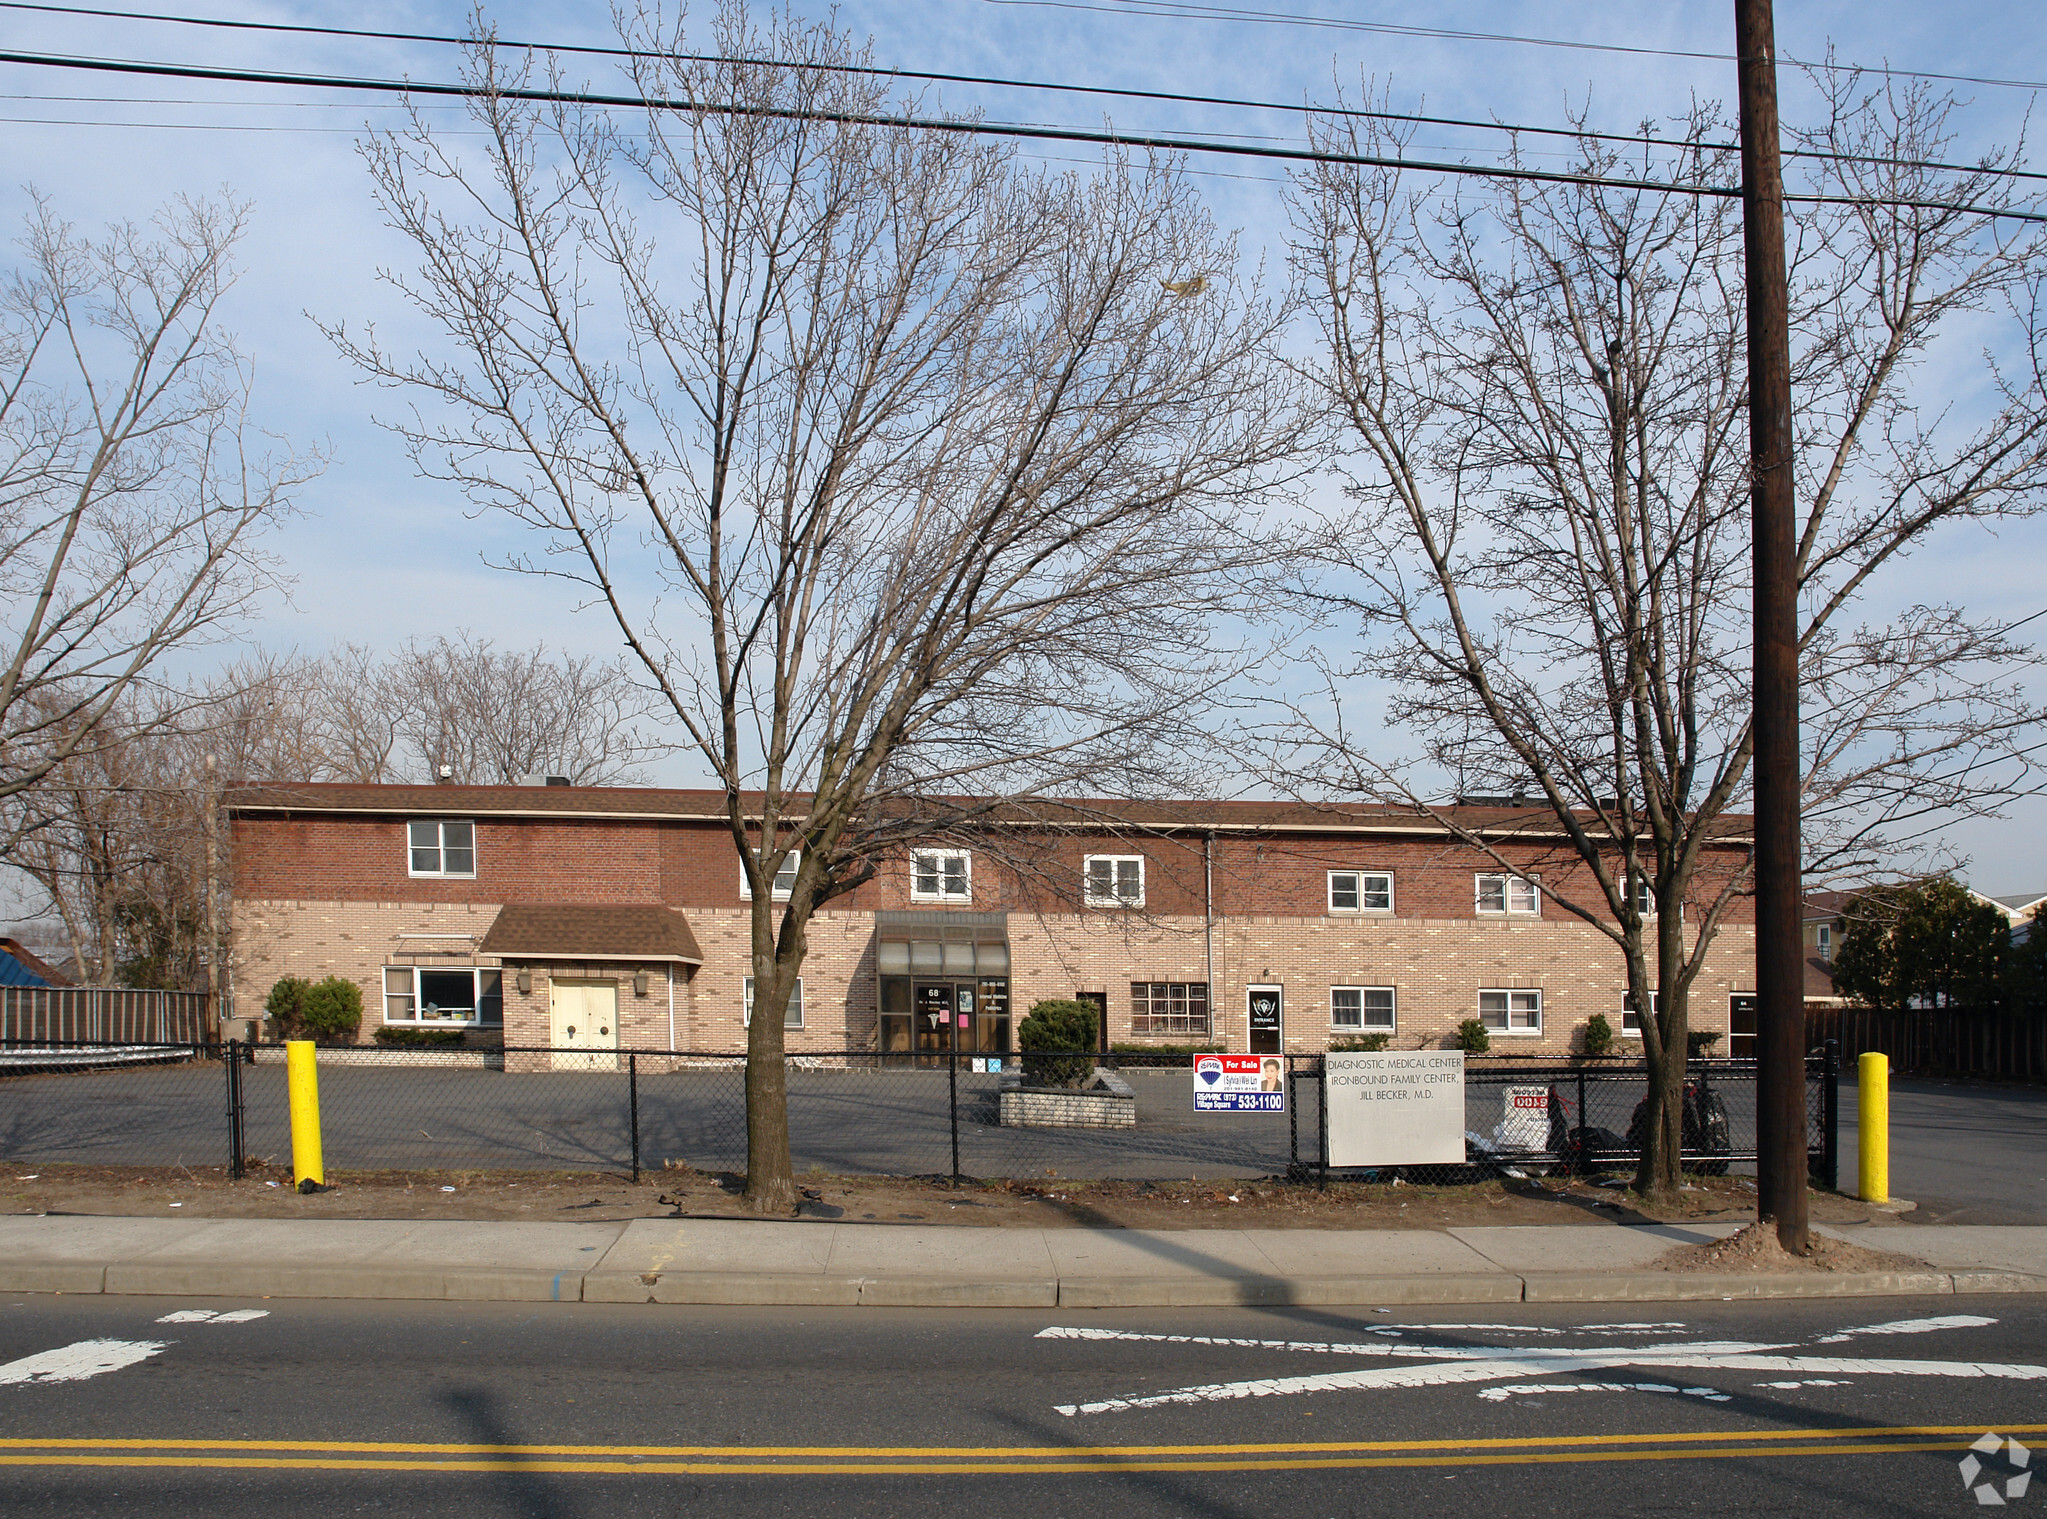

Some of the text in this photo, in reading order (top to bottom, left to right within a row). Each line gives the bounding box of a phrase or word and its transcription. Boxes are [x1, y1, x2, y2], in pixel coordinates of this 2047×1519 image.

[928, 989, 939, 997] 68
[1226, 1061, 1258, 1069] For Sale
[1328, 1058, 1462, 1070] DIAGNOSTIC MEDICAL CENTER
[1331, 1073, 1460, 1086] IRONBOUND FAMILY CENTER,
[1360, 1089, 1434, 1101] JILL BECKER, M.D.
[1197, 1100, 1231, 1110] Village Square
